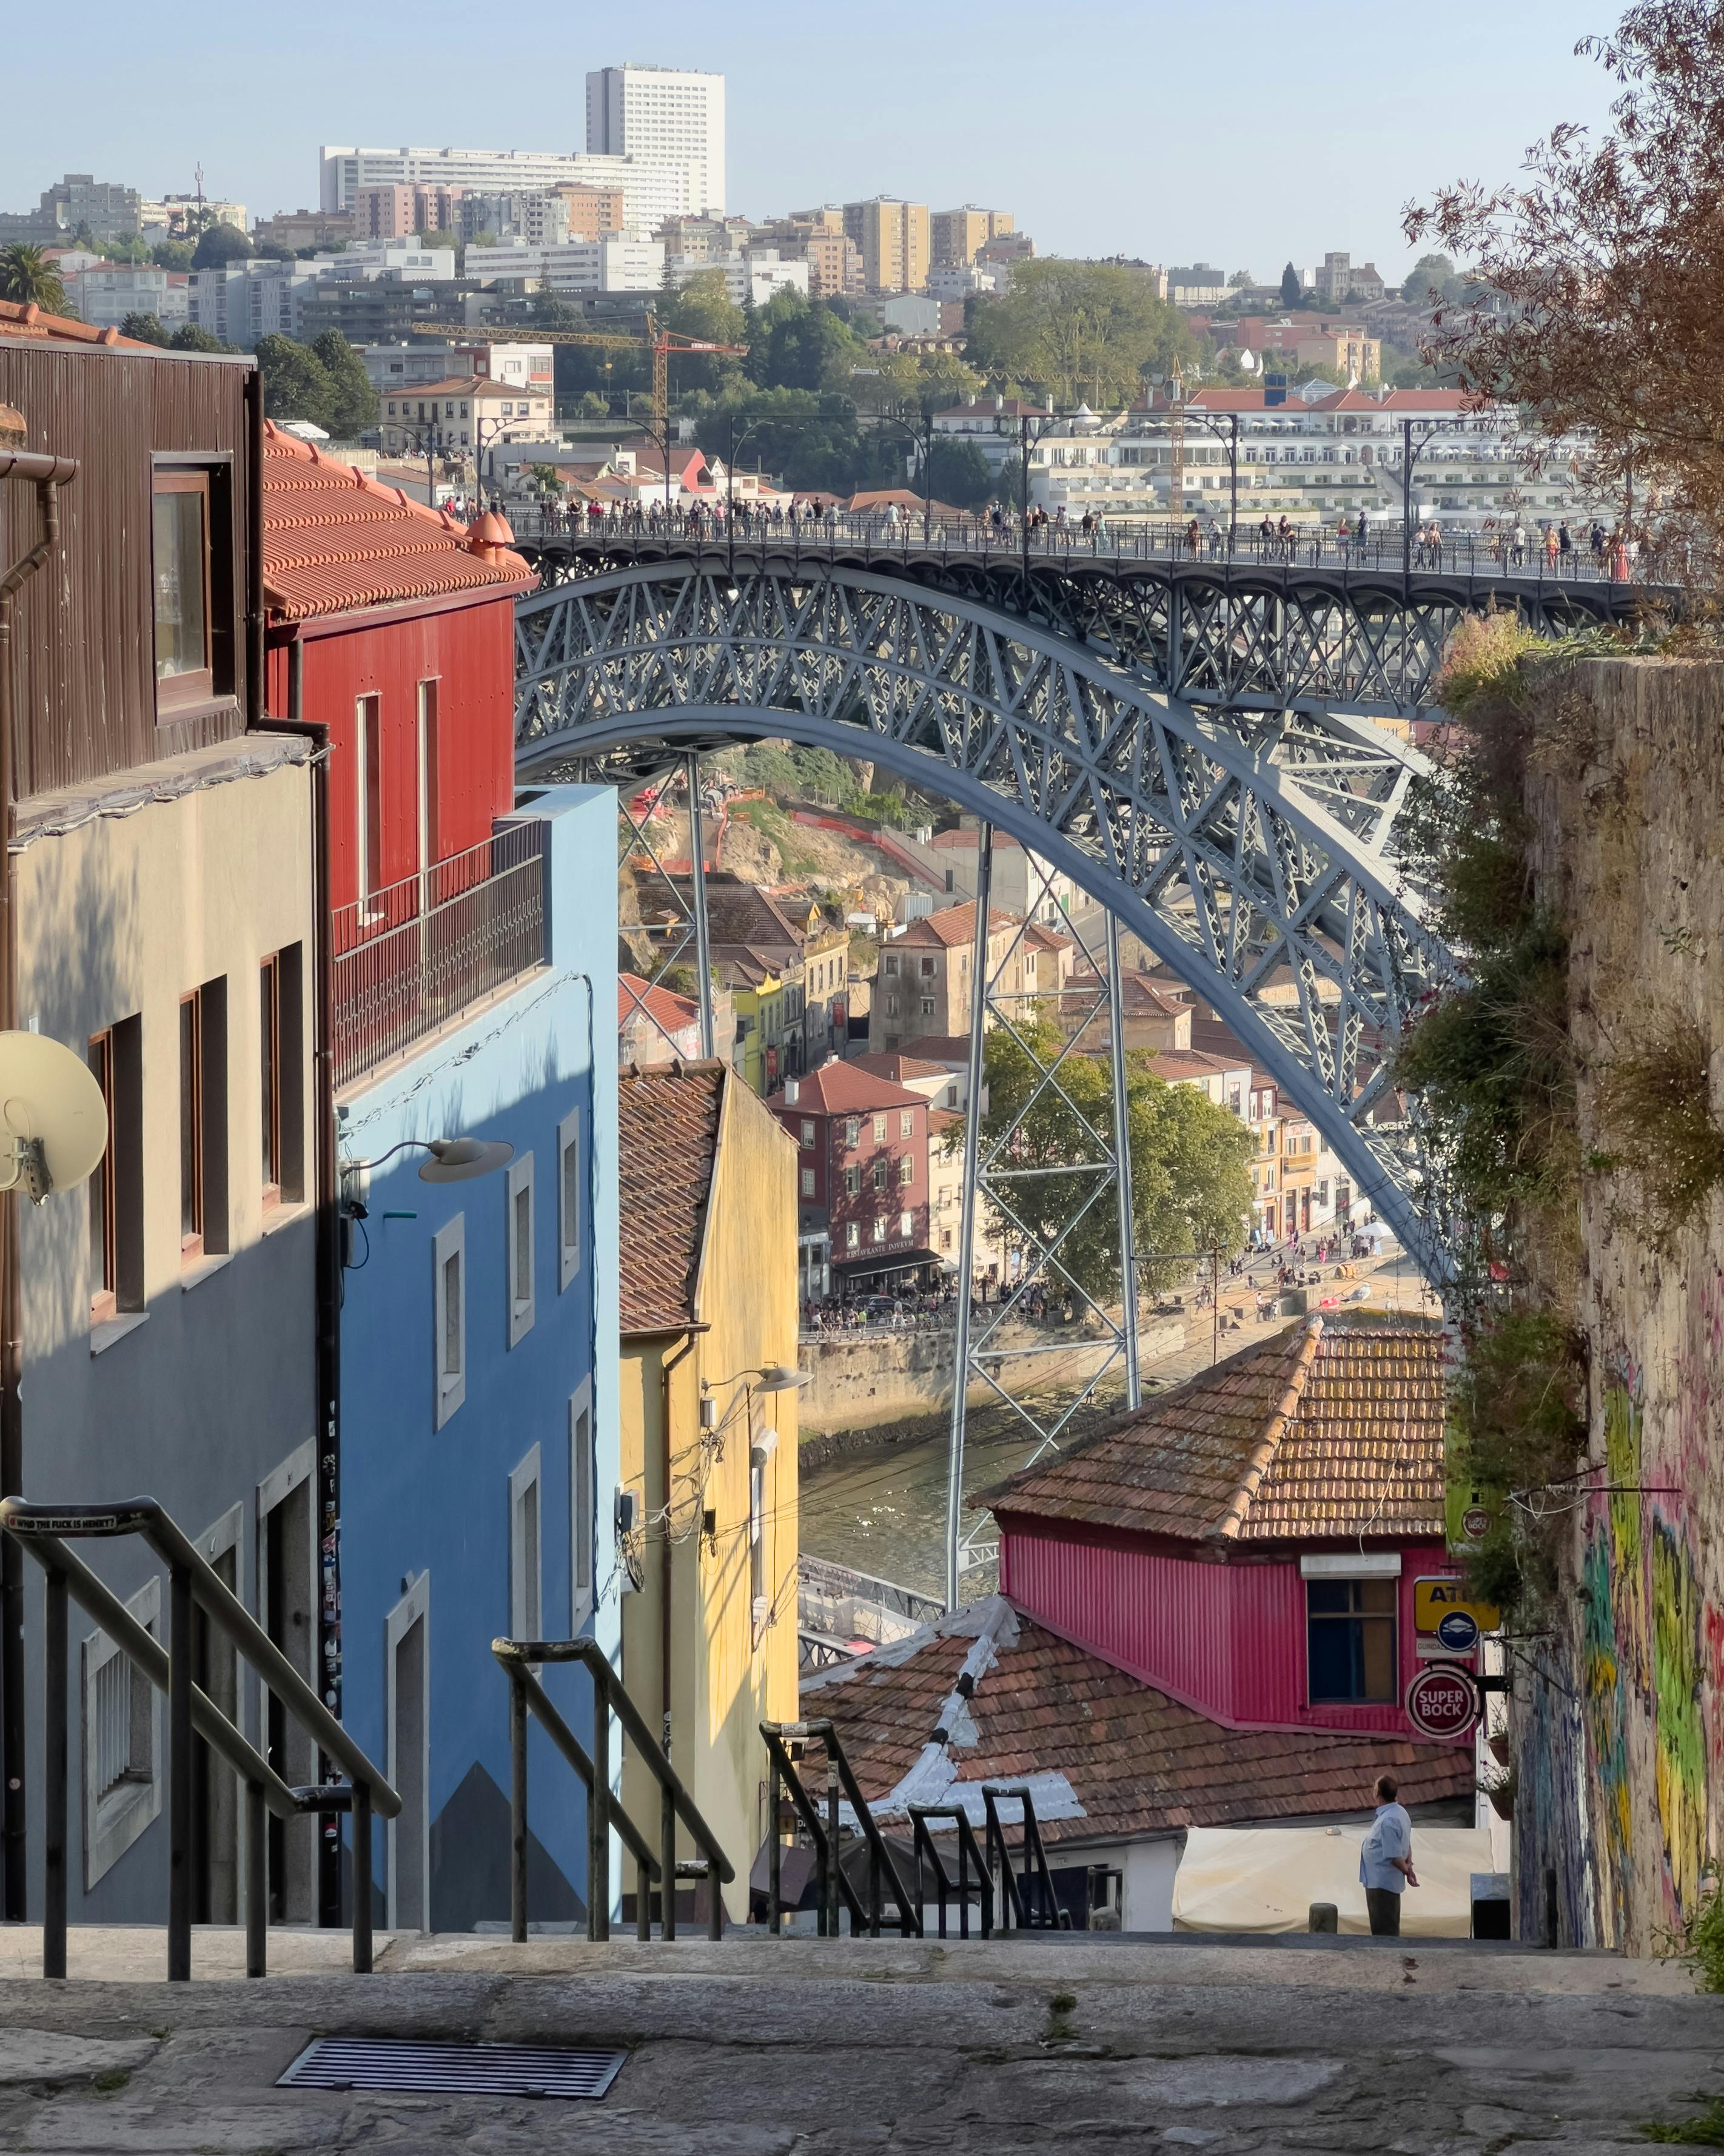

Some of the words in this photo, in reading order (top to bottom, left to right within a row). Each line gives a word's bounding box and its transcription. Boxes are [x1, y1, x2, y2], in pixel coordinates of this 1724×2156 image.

[17, 1519, 35, 1528] WHO
[36, 1520, 50, 1528] THE
[82, 1519, 114, 1528] HENRY?
[1418, 1690, 1464, 1704] SUPER
[1421, 1704, 1462, 1716] BOCK
